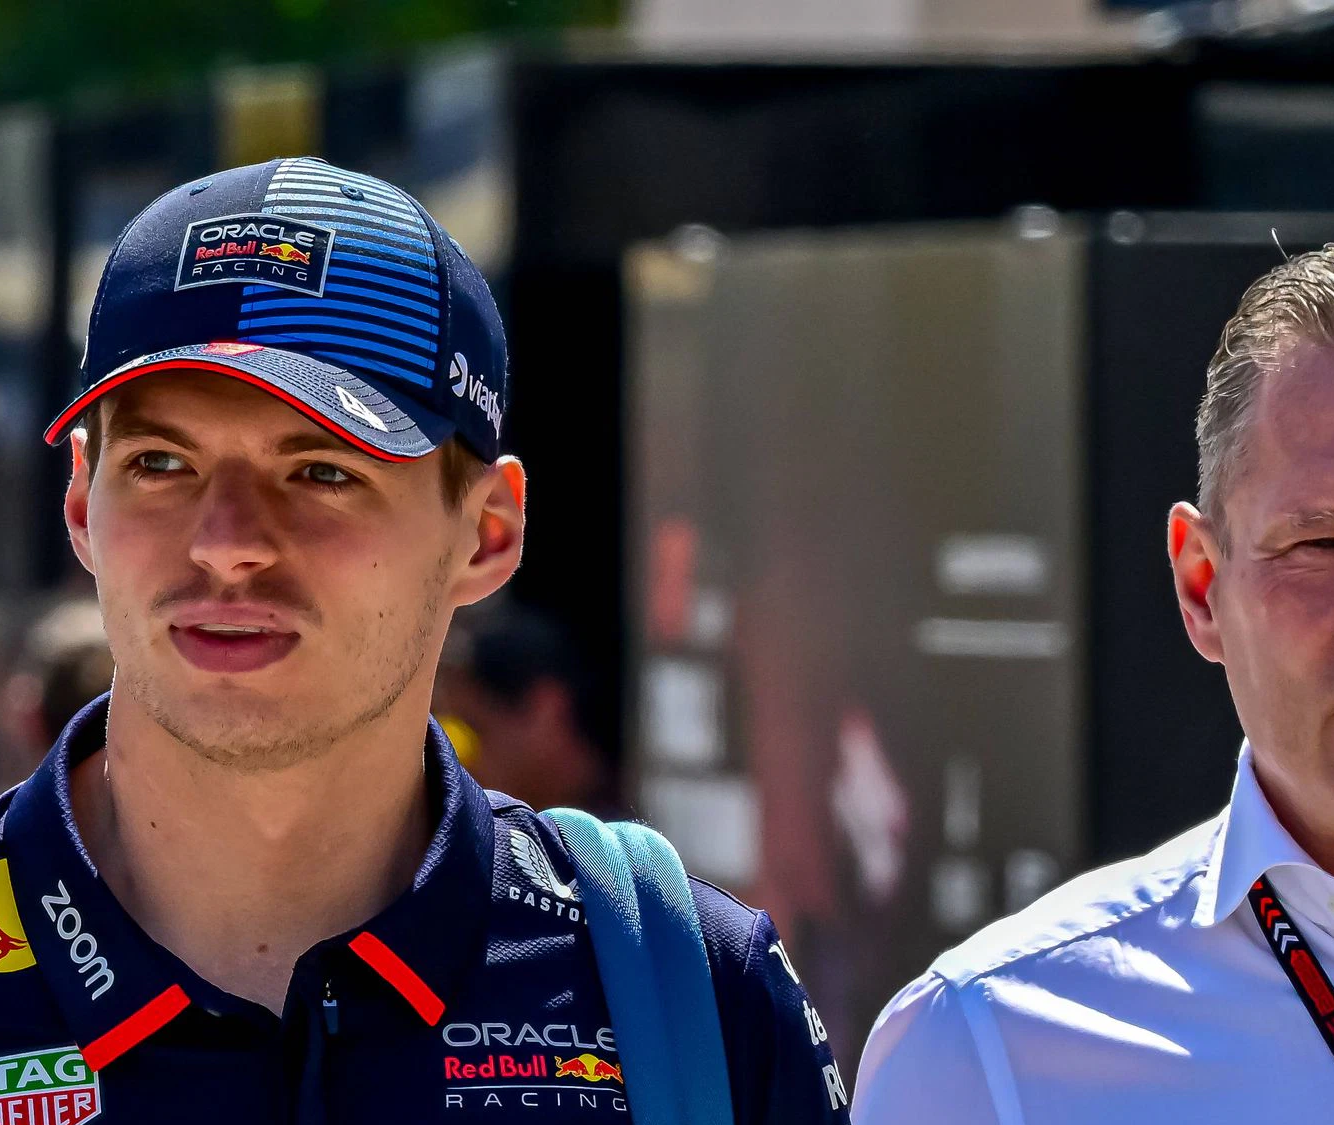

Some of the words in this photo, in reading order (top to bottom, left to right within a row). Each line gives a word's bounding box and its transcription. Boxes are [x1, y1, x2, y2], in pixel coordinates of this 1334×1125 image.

[199, 223, 316, 248] ORACLE
[195, 243, 226, 261] Red
[225, 240, 257, 256] Bull
[191, 262, 309, 282] RACING
[509, 886, 588, 925] CASTO
[41, 879, 115, 1001] zoom
[442, 1022, 617, 1051] ORACLE
[444, 1054, 496, 1079] Red
[499, 1055, 548, 1077] Bull
[445, 1093, 628, 1112] RACING
